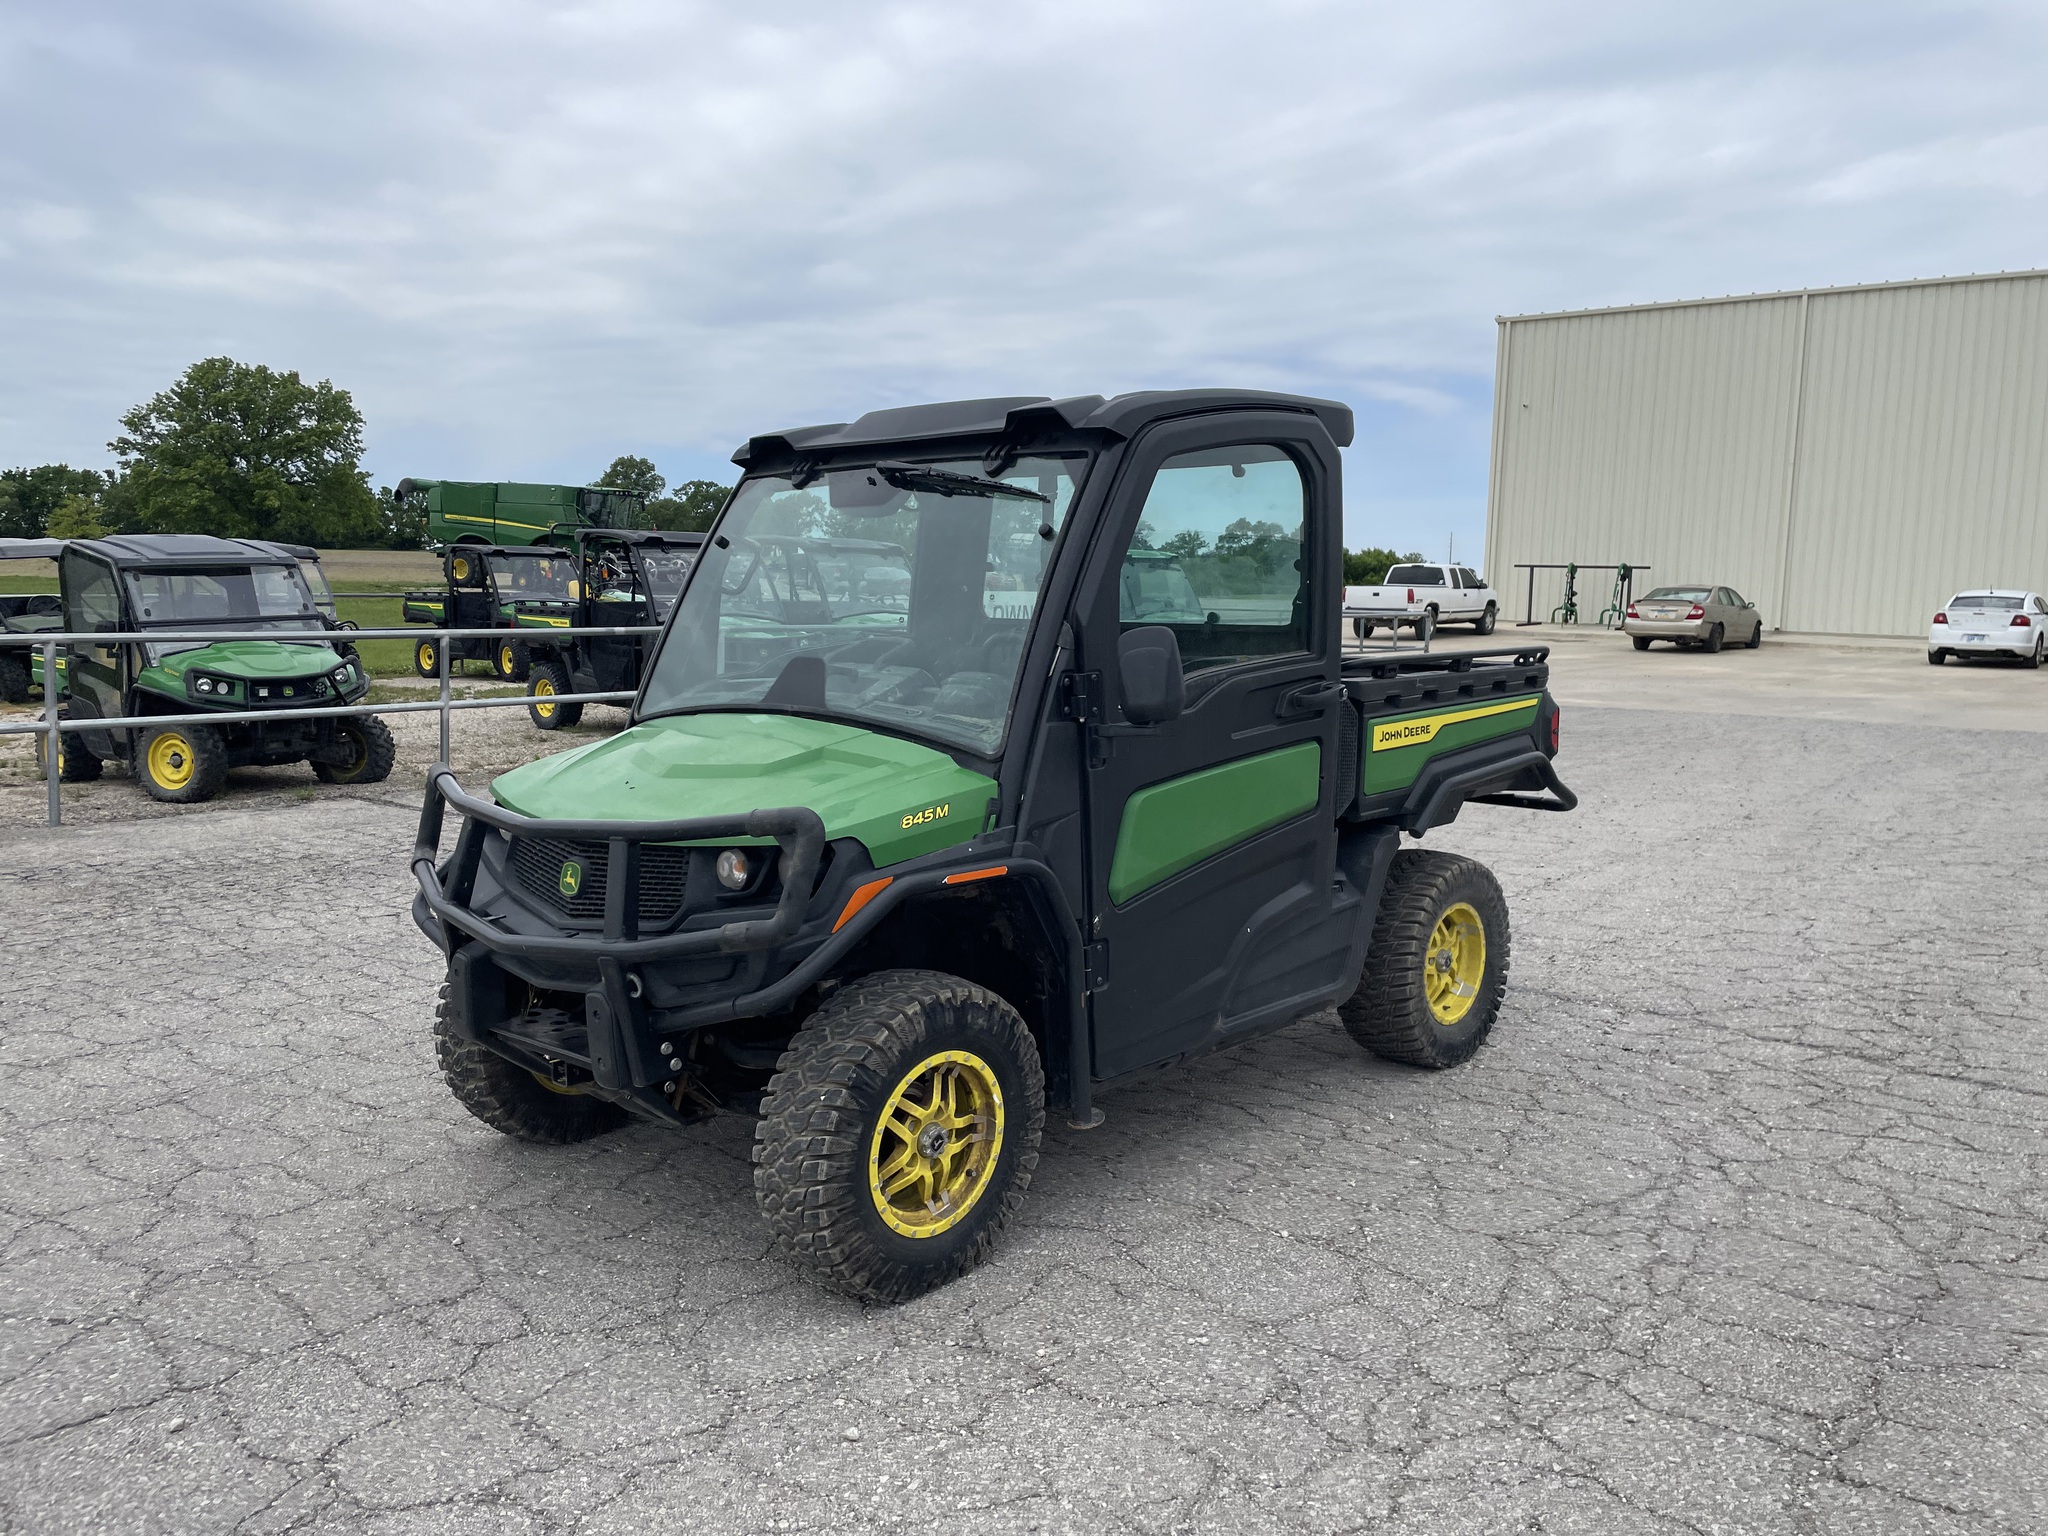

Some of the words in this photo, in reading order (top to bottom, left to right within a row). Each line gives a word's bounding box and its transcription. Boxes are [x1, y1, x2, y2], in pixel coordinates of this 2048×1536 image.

[1379, 730, 1402, 743] JOHN
[1404, 725, 1431, 738] DEERE
[901, 803, 949, 829] 845M
